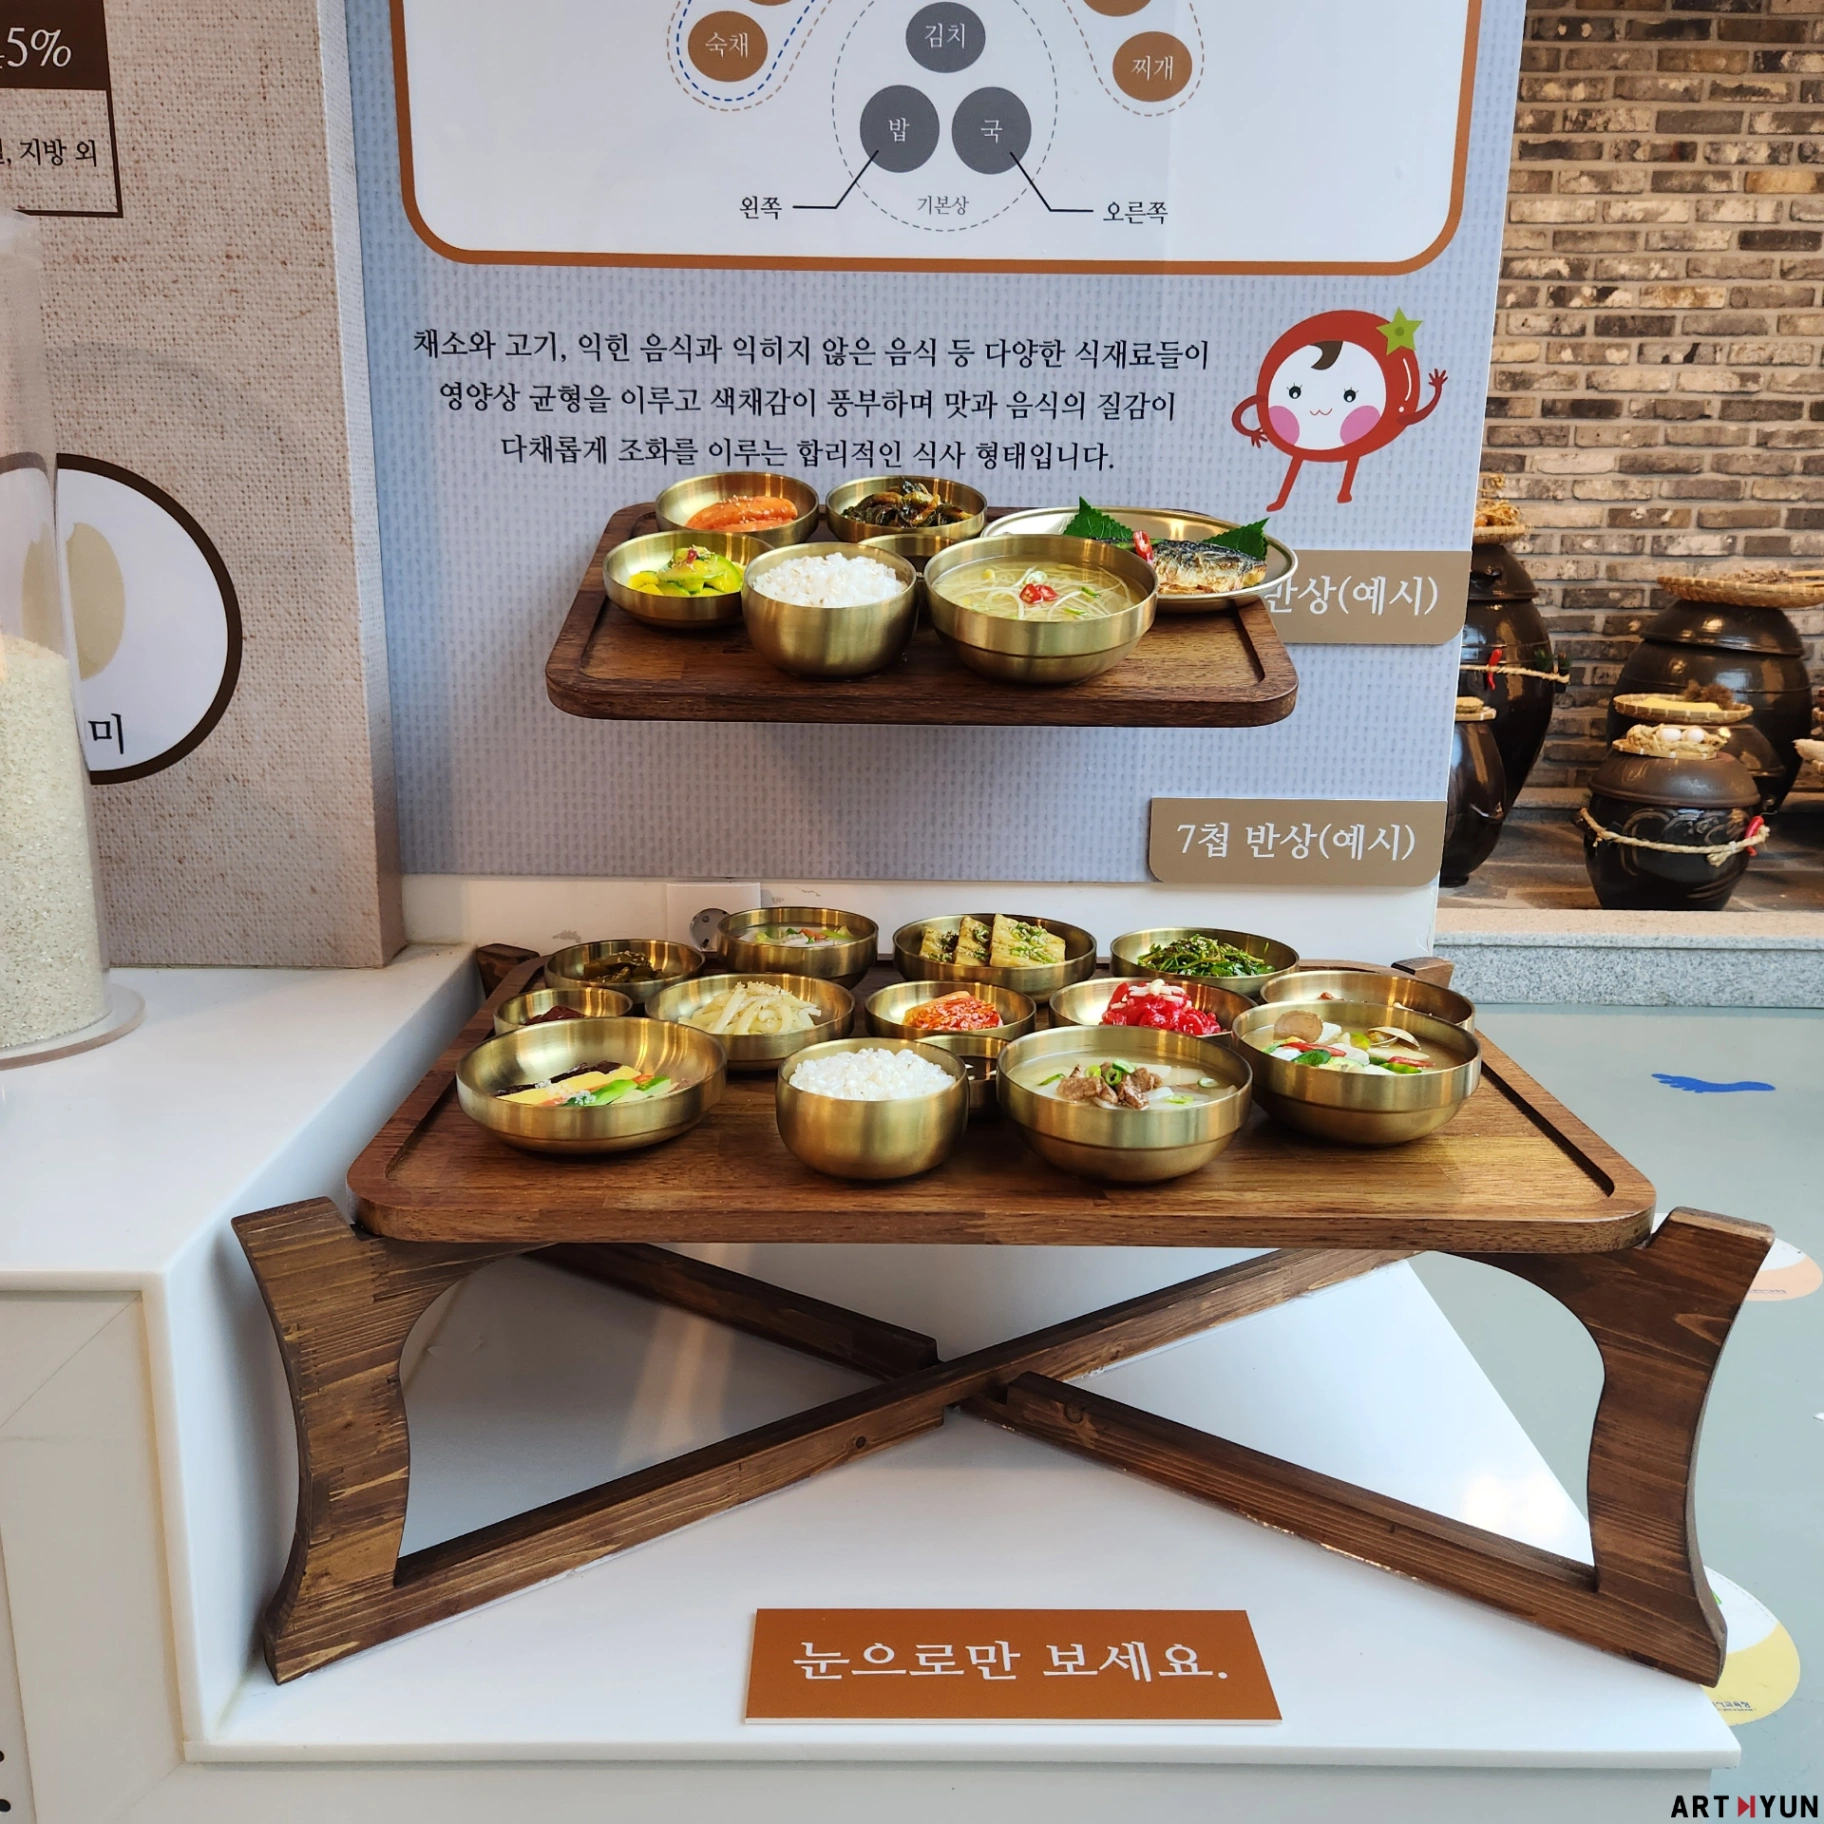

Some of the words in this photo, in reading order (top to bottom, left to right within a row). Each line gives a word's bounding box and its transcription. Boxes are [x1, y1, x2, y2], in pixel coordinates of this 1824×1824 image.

[0, 27, 72, 67] 5%
[705, 32, 749, 58] 숙채
[924, 22, 966, 49] 김치
[1131, 55, 1175, 81] 찌개
[888, 117, 910, 142] 밥
[979, 119, 1003, 144] 국
[20, 139, 67, 166] 지방
[76, 140, 96, 167] 외
[740, 196, 782, 220] 왼쪽
[916, 196, 970, 216] 기본상
[1104, 202, 1167, 224] 오른쪽
[414, 329, 496, 359] 채소와
[506, 332, 566, 362] 고기,
[579, 333, 629, 361] 익힌
[640, 334, 722, 364] 음식과
[734, 336, 809, 365] 익히지
[823, 337, 875, 366] 않은
[885, 337, 935, 367] 음식
[948, 340, 974, 367] 등
[986, 339, 1065, 368] 다양한
[1076, 340, 1207, 369] 식재료들이
[440, 382, 520, 411] 영양상
[529, 384, 611, 413] 균형을
[622, 386, 700, 414] 이루고
[711, 387, 814, 417] 색채감이
[828, 390, 931, 418] 풍부하며
[945, 390, 998, 419] 맛과
[1006, 391, 1085, 420] 음식의
[1098, 392, 1174, 421] 질감이
[501, 434, 606, 464] 다채롭게
[619, 437, 698, 465] 조화를
[709, 438, 787, 466] 이루는
[797, 439, 901, 468] 합리적인
[914, 441, 965, 469] 식사
[976, 442, 1113, 471] 형태입니다.
[1178, 822, 1228, 857] 7첩
[1246, 823, 1415, 860] 반상(예시)
[794, 1641, 1020, 1679] 눈으로만
[1043, 1642, 1227, 1682] 보세요.
